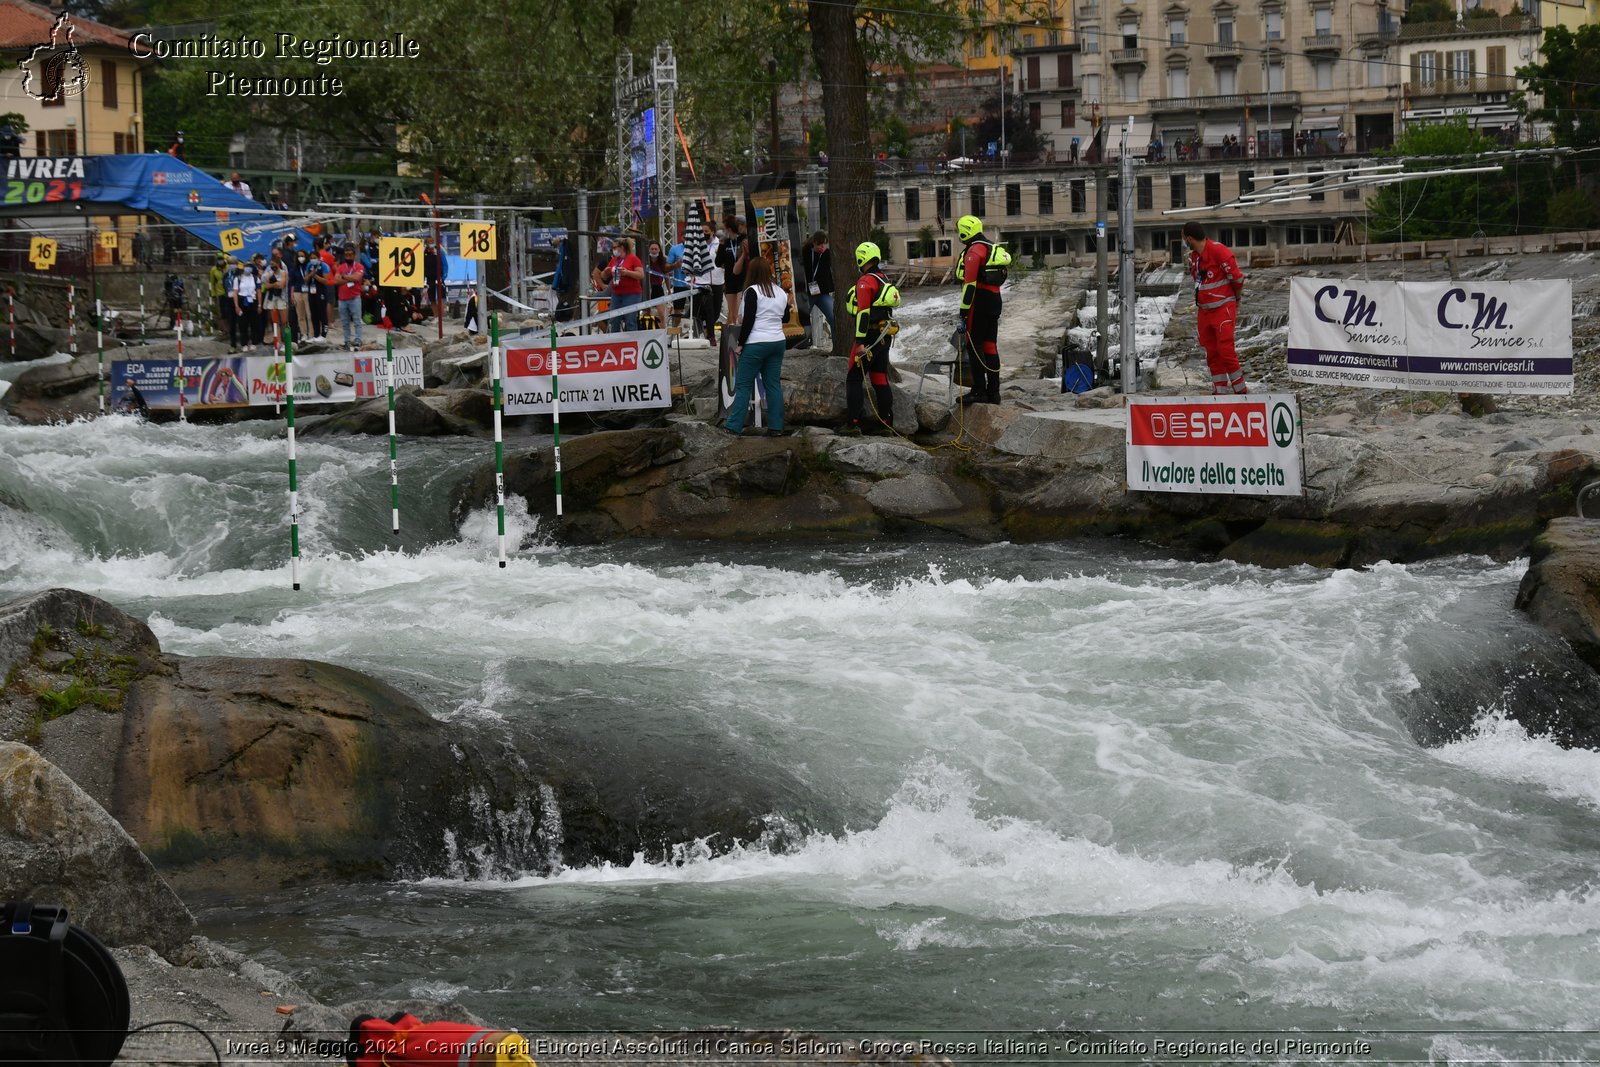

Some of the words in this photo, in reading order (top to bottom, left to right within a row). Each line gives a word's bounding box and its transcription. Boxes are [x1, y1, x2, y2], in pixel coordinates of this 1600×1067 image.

[7, 157, 85, 178] IVREA
[4, 180, 82, 203] 2021
[764, 206, 777, 241] KIND
[36, 242, 52, 259] 16
[225, 232, 240, 247] 15
[467, 229, 490, 253] 18
[388, 246, 416, 278] 19
[1343, 322, 1391, 343] Service
[1470, 326, 1525, 349] Service
[126, 363, 145, 374] ECA
[527, 348, 636, 371] DESPAR
[1318, 352, 1398, 369] www.cmservicesrl.it
[1440, 359, 1535, 372] www.cmservicesrl.it
[1291, 368, 1314, 378] GLOBAL
[1315, 370, 1339, 380] SERVICE
[1340, 372, 1371, 382] PROVIDER
[1372, 376, 1404, 385] SANIFICAZIONE
[1461, 380, 1503, 389] PROGETTAZIONE
[1506, 381, 1527, 389] EDILIZIA
[1529, 381, 1572, 389] MANUTENZIONE
[507, 392, 544, 405] PIAZZA
[560, 389, 589, 403] CITTA'
[593, 388, 605, 401] 21
[611, 383, 662, 403] IVREA
[1151, 411, 1265, 437] DESPAR
[1142, 460, 1149, 482] Il
[1152, 461, 1195, 484] valore
[1200, 462, 1236, 485] della
[1241, 463, 1285, 486] scelta
